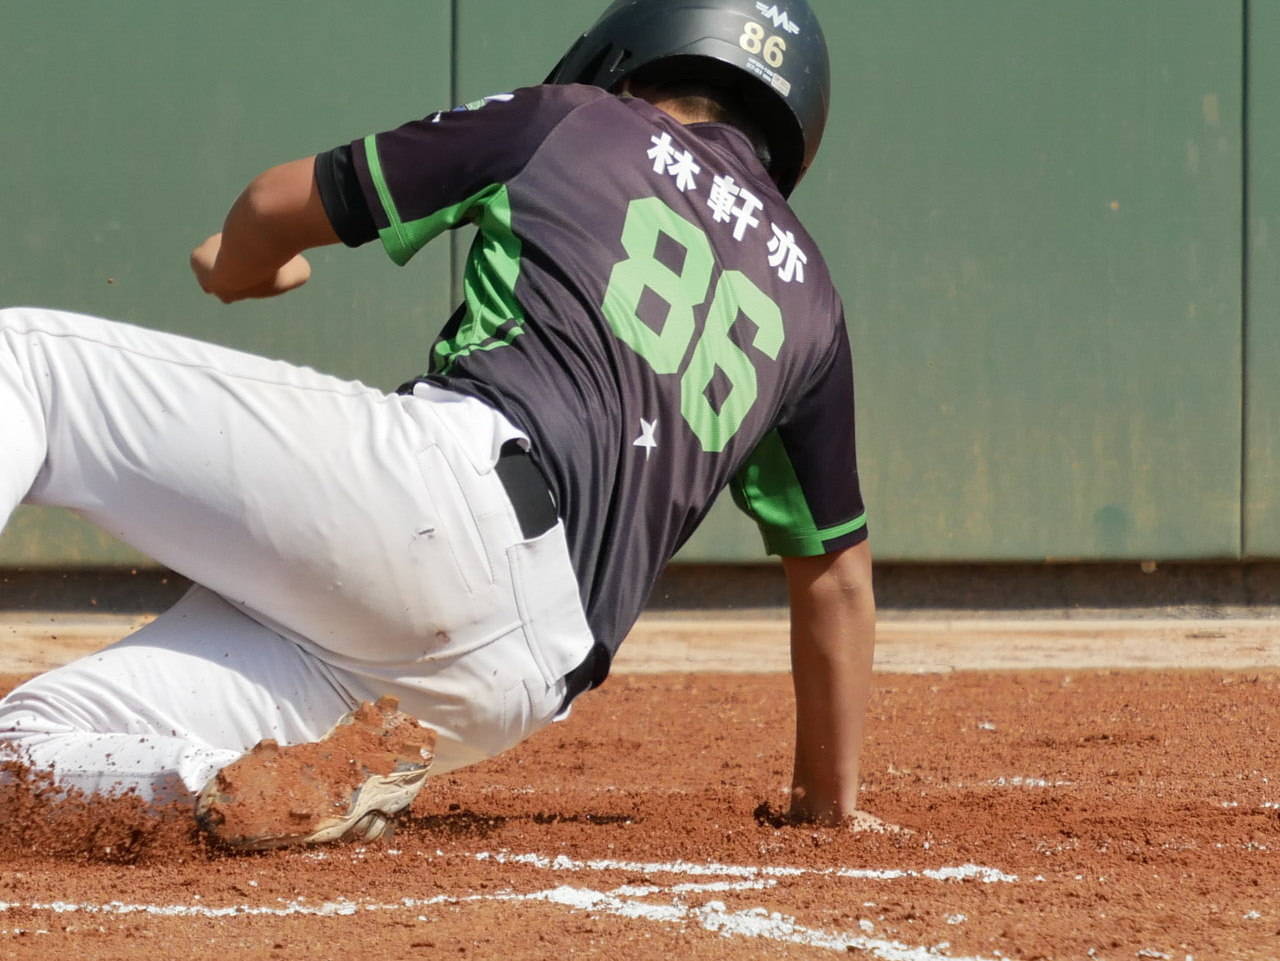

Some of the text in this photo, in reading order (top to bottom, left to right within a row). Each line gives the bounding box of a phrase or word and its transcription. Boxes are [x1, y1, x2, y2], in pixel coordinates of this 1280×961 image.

[739, 22, 786, 67] 86
[646, 131, 808, 283] 林軒亦
[601, 196, 785, 452] 86
